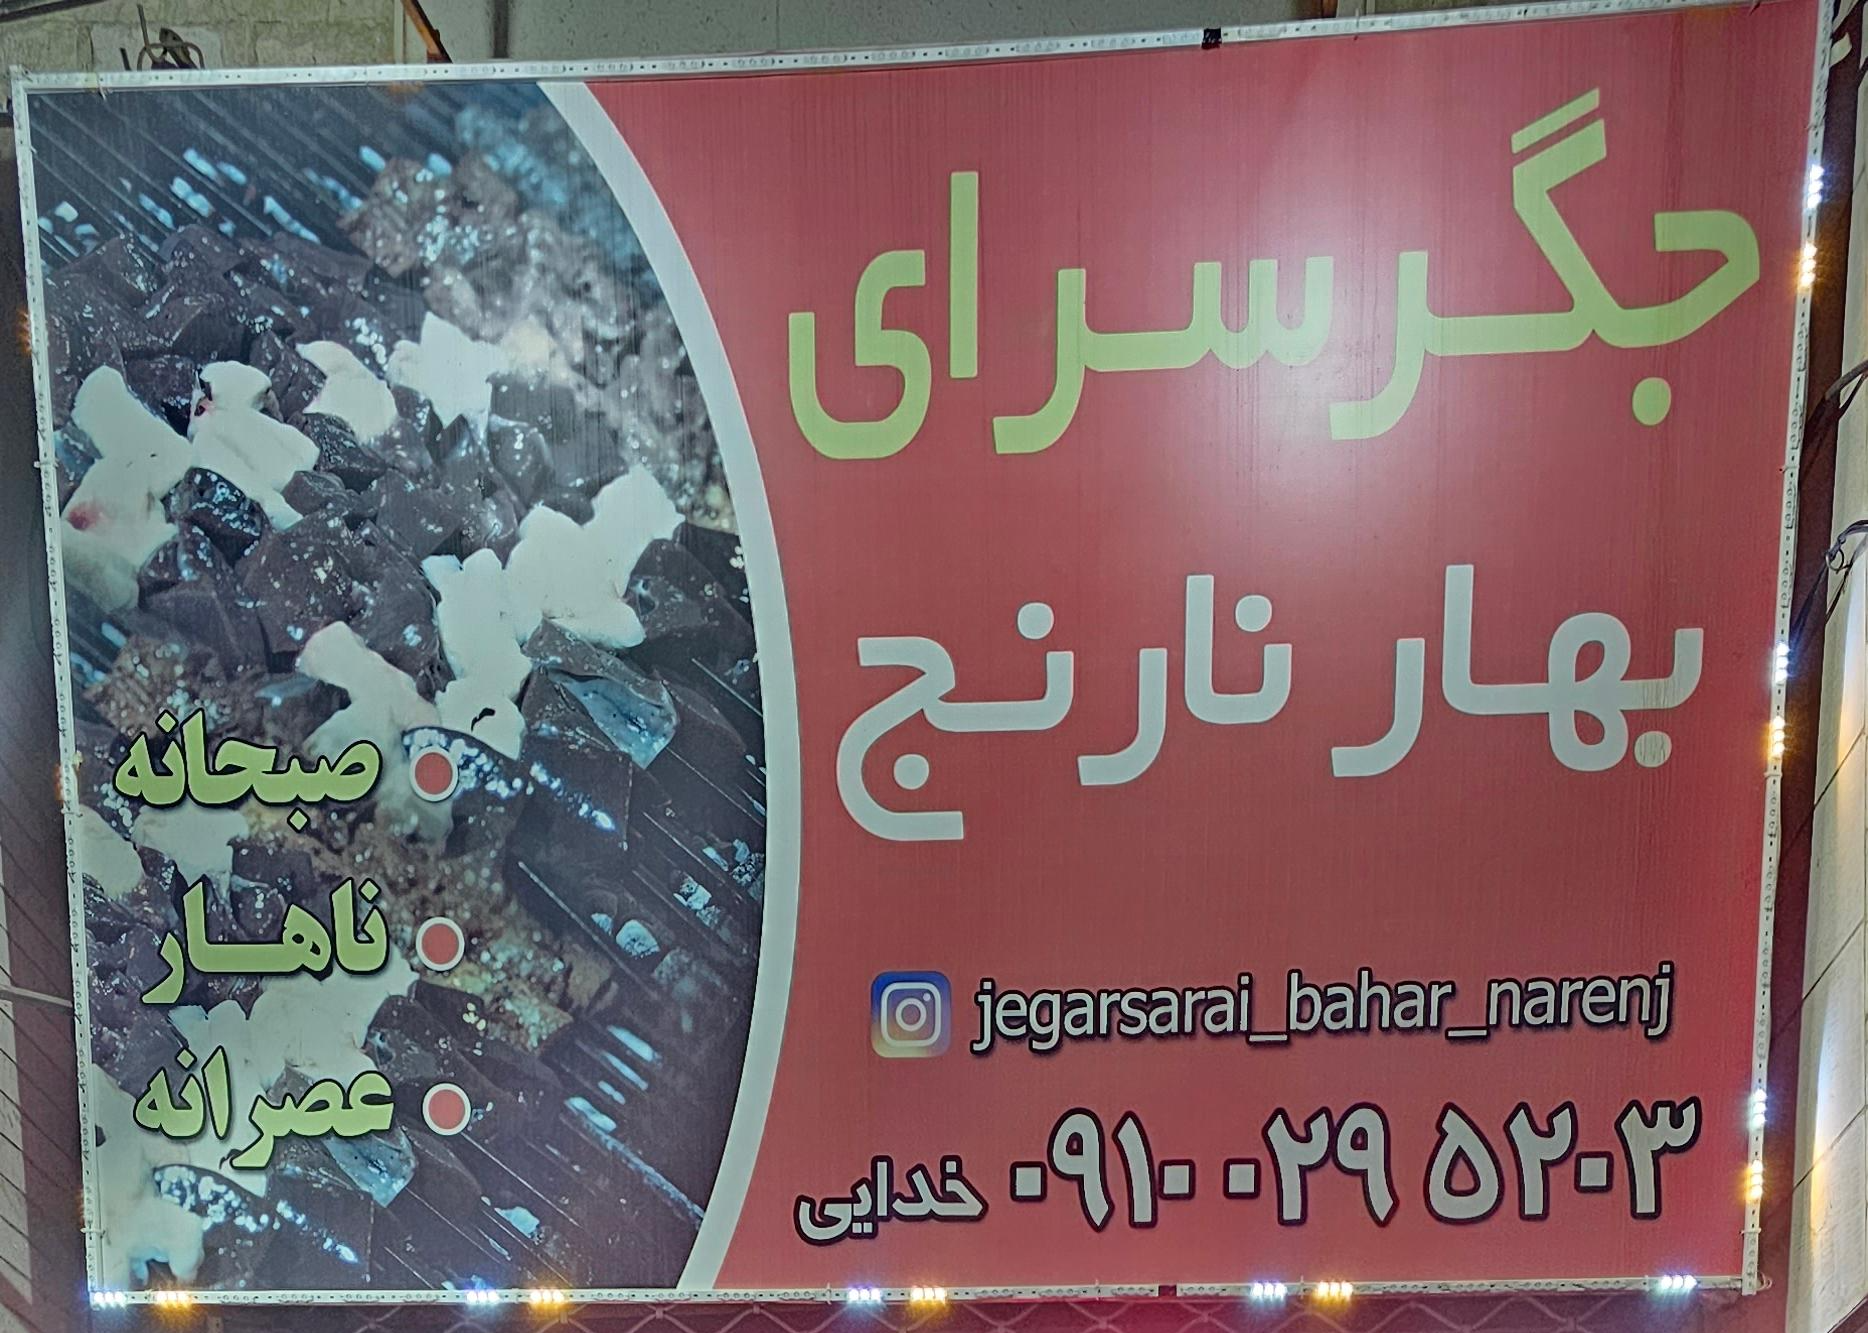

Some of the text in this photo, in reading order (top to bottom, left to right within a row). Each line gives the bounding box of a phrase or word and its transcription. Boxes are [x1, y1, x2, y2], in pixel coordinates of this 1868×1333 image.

[836, 564, 1704, 842] بهار نارنج
[114, 708, 382, 830] صبحانه
[140, 878, 389, 1006] ناهار
[969, 962, 1674, 1055] jegarsarai_bahar_narenj
[132, 1046, 396, 1170] عصرانه
[793, 1154, 989, 1247] خدایی
